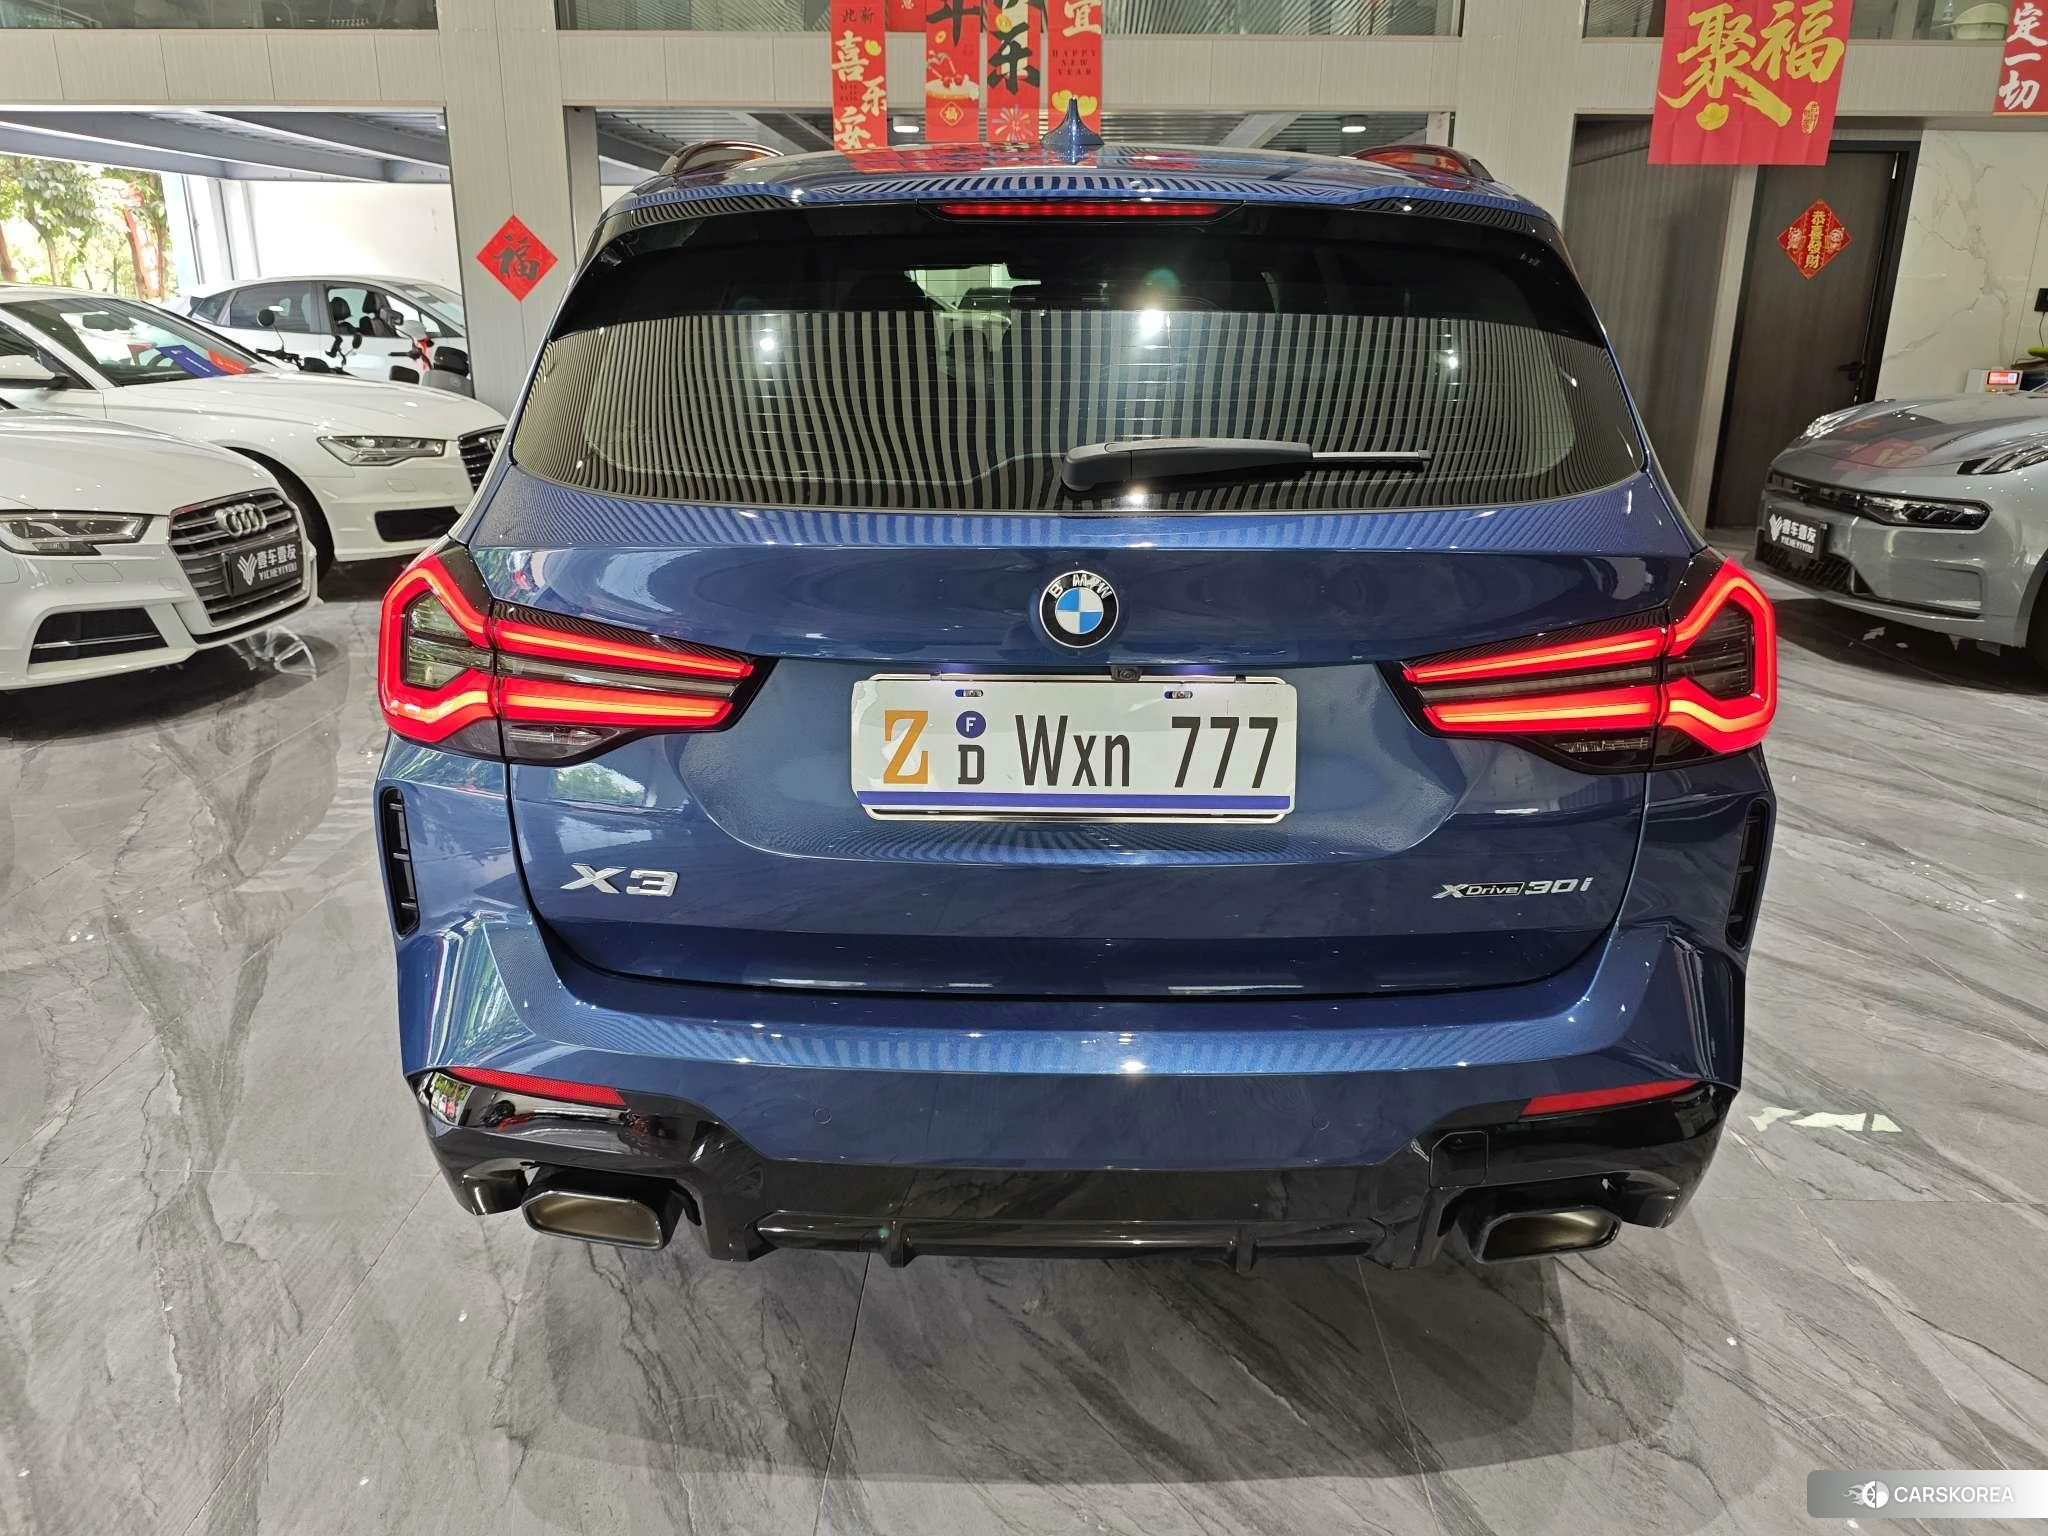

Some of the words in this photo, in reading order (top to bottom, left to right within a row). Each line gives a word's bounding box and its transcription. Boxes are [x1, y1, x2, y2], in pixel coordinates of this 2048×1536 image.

[987, 0, 1043, 95] 乐
[493, 234, 540, 281] 福
[1048, 573, 1113, 599] BMW
[883, 710, 929, 785] Z
[958, 744, 985, 785] D
[1015, 715, 1131, 788] Wxn
[1171, 716, 1279, 789] 777
[560, 862, 679, 897] X3
